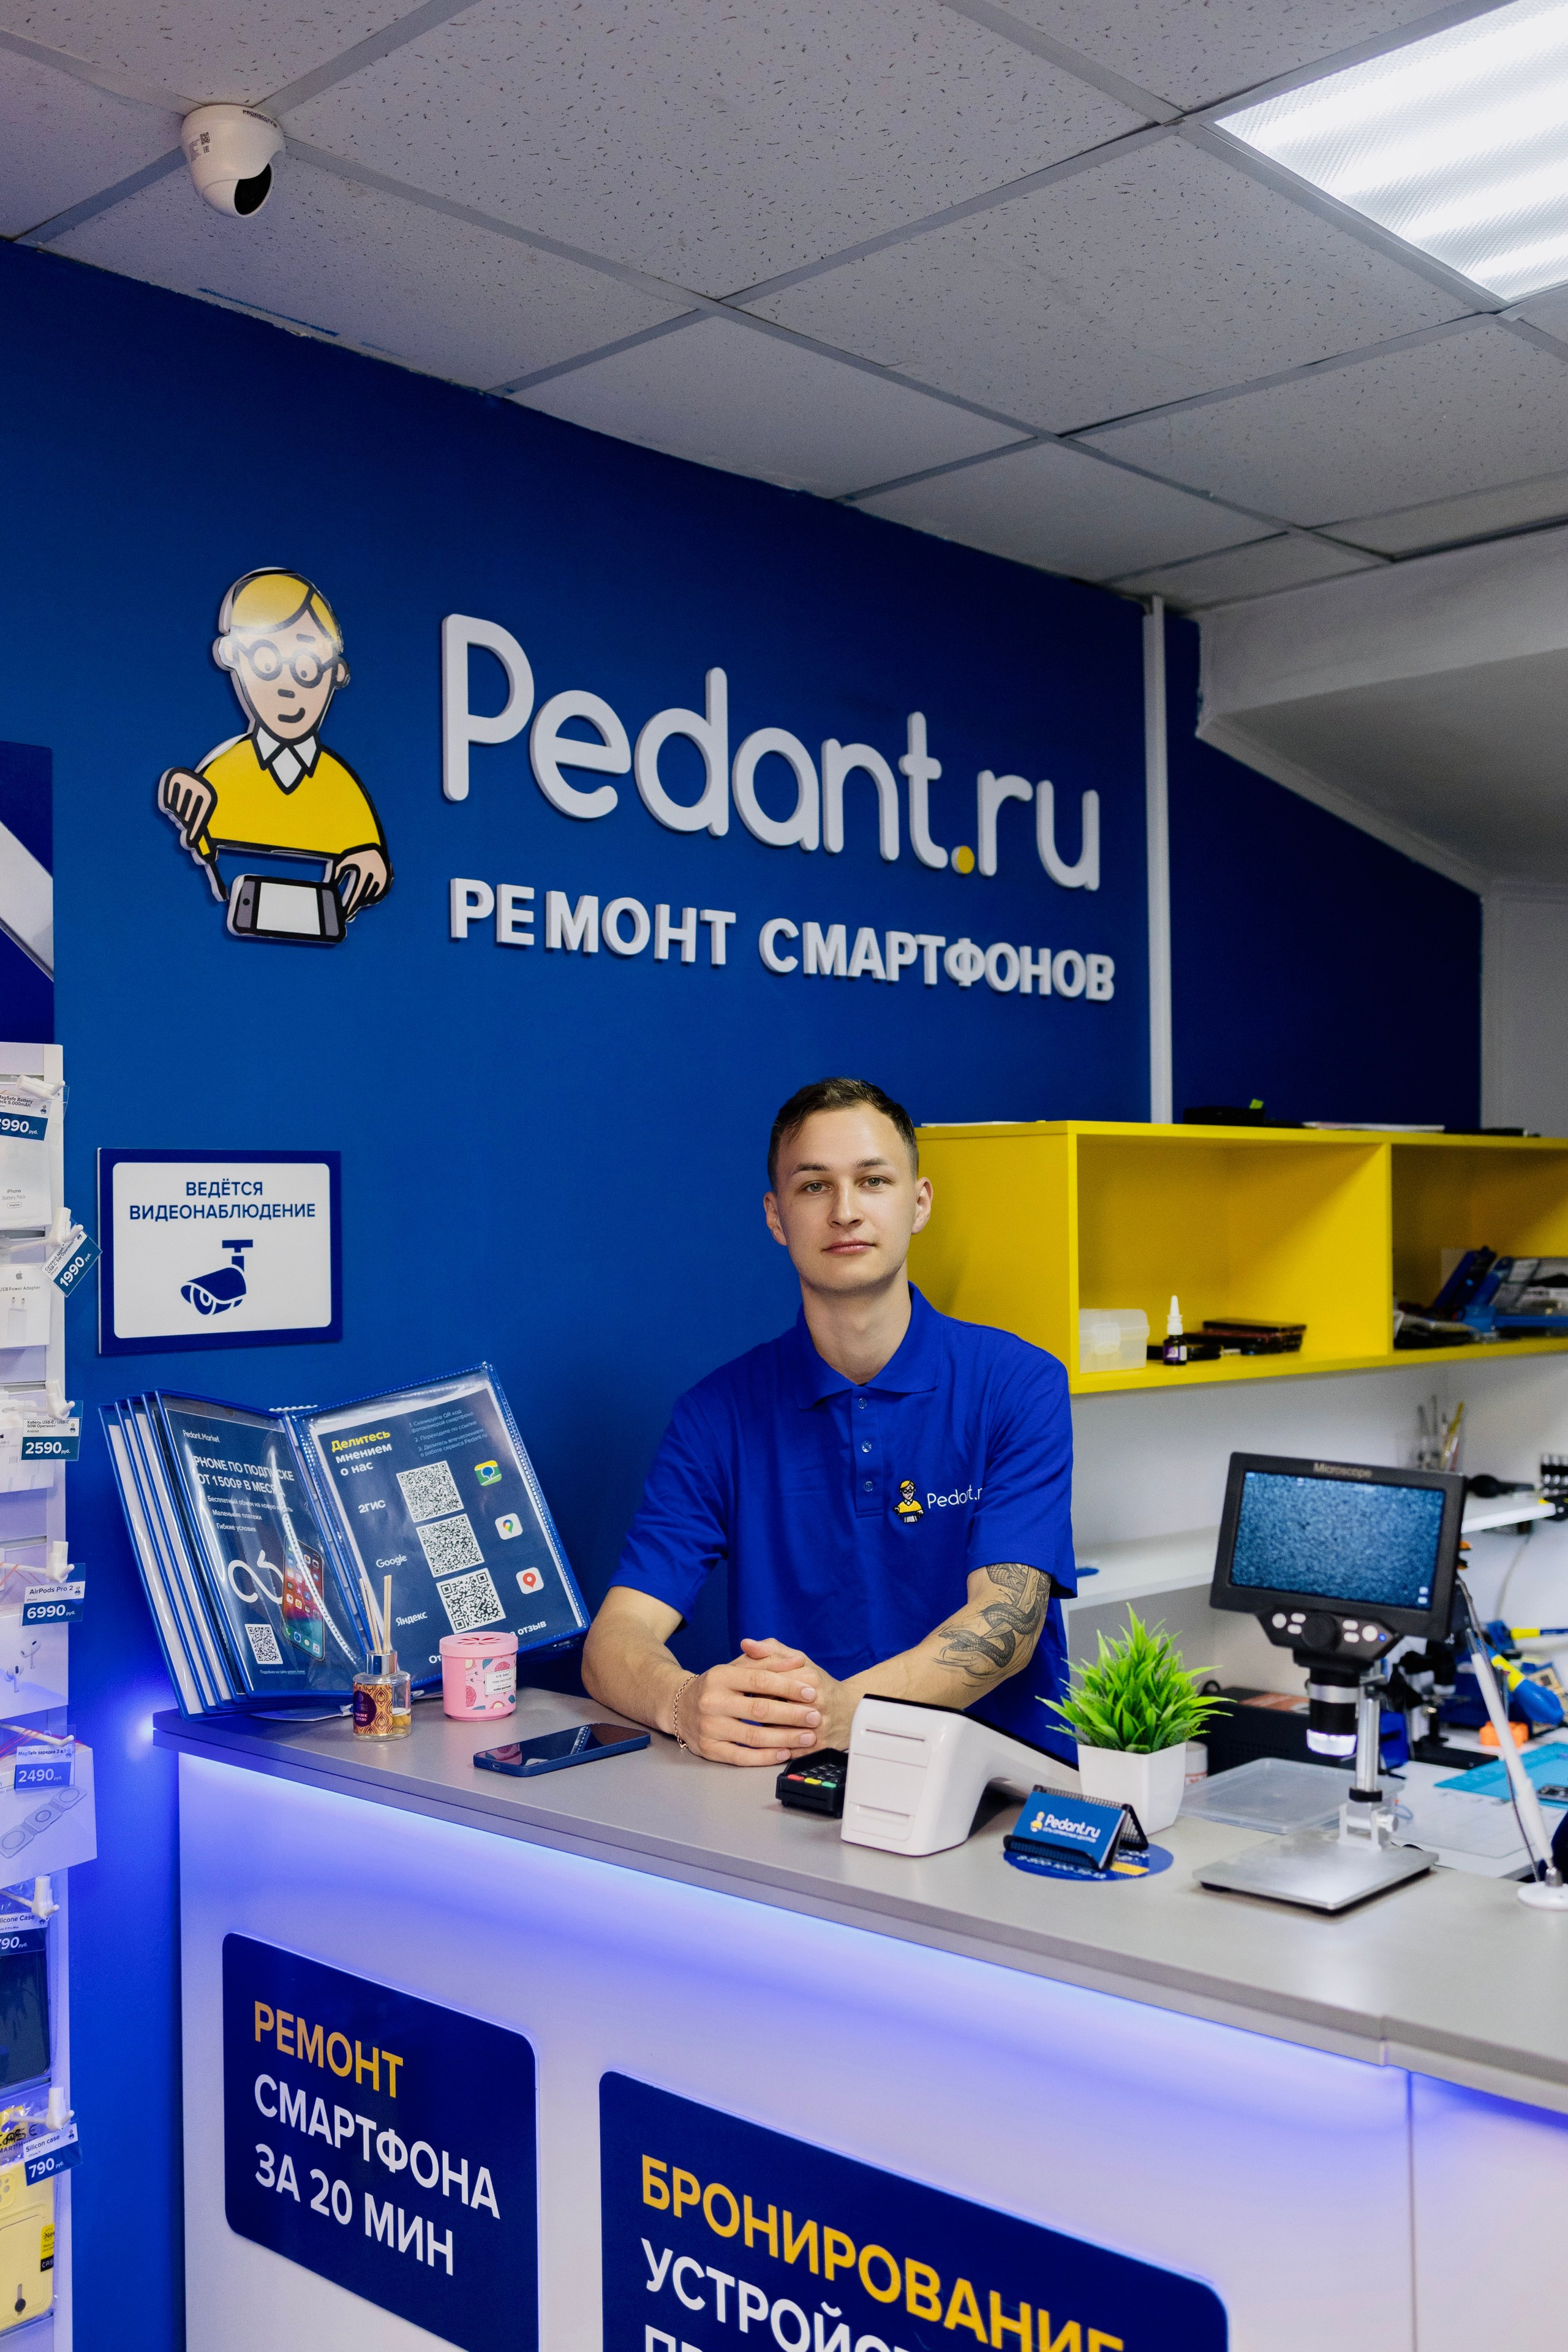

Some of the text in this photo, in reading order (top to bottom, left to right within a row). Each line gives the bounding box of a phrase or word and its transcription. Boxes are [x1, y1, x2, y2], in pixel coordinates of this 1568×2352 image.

[442, 613, 1100, 891] Pedant.ru
[450, 877, 1115, 1001] РЕМОНТ СМАРТФОНОВ
[0, 1118, 29, 1133] 990
[186, 1178, 263, 1198] ВЕДЁТСЯ
[129, 1203, 315, 1222] ВИДЕОНАБЛЮДЕНИЕ
[60, 1256, 85, 1287] 1990
[411, 1411, 474, 1434] фотокамерой смартфона
[413, 1415, 443, 1427] Сканируйте
[420, 1429, 451, 1441] Переходите
[458, 1420, 477, 1430] ссылке
[183, 1430, 221, 1443] Pedant.Market
[331, 1431, 391, 1453] Делитесь
[423, 1441, 448, 1451] Делитесь
[448, 1428, 484, 1444] впечатлением
[424, 1447, 443, 1457] работе
[443, 1441, 464, 1451] сервиса
[464, 1433, 488, 1445] Pedant.ru
[25, 1441, 62, 1455] 2590
[335, 1442, 393, 1464] мнением
[191, 1454, 228, 1471] PHONE
[227, 1461, 243, 1473] ПО
[340, 1461, 374, 1477] о нас
[197, 1473, 211, 1485] ОТ
[243, 1480, 252, 1491] В
[212, 1509, 242, 1518] Маленькие
[358, 1499, 386, 1514] 2ГИС
[375, 1554, 407, 1569] Google
[27, 1604, 66, 1619] 6990
[395, 1611, 428, 1627] Яндекс
[517, 1620, 547, 1636] отзыв
[18, 1768, 55, 1783] 2490
[0, 1936, 20, 1950] 90
[254, 2000, 404, 2099] РЕМОНТ
[26, 2135, 60, 2152] Silicon case
[254, 2073, 500, 2220] СМАРТФОНА
[28, 2157, 55, 2178] 790
[255, 2144, 453, 2276] ЗА 20 МИН
[641, 2237, 911, 2352] УСТРОЙ
